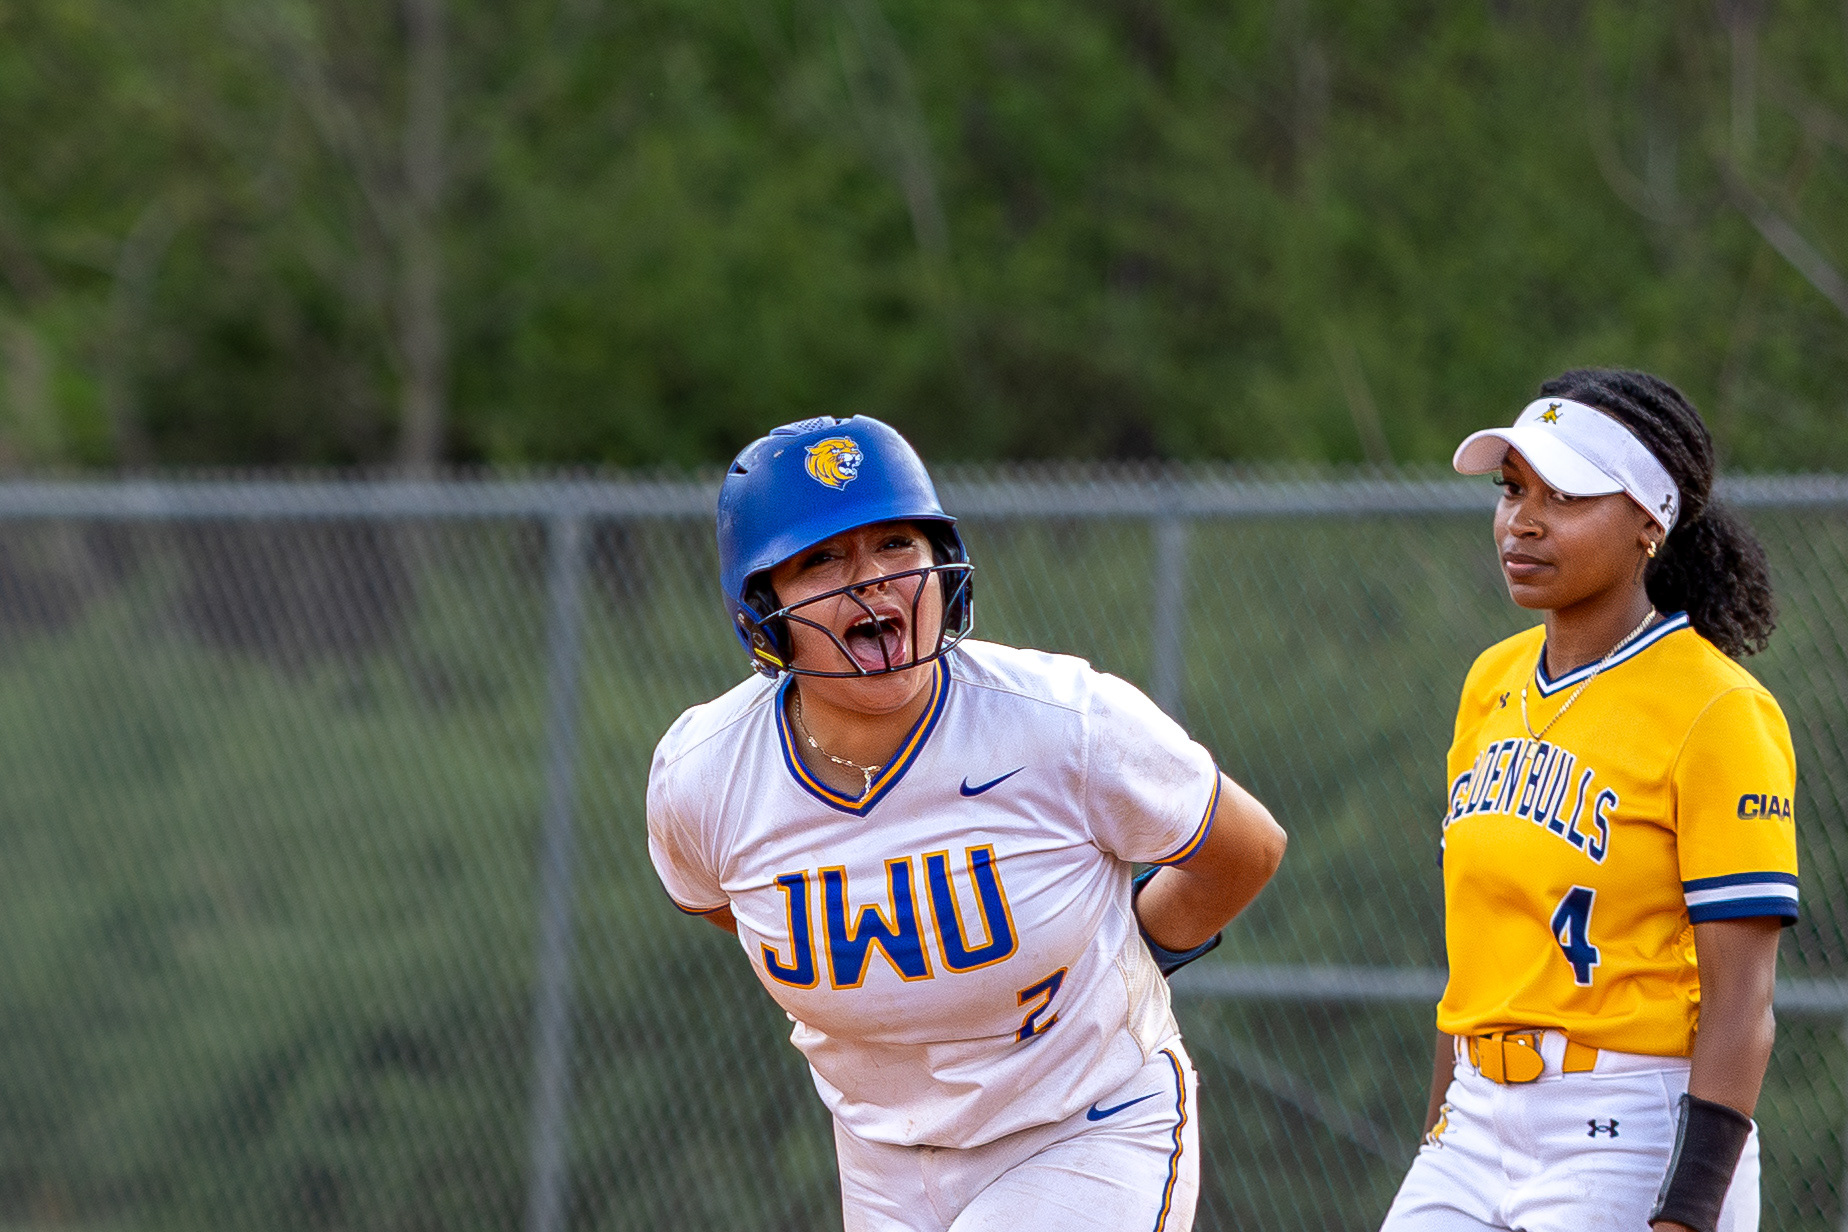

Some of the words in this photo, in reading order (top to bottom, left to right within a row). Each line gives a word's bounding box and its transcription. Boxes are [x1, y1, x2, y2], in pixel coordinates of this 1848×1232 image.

[1515, 739, 1619, 865] BULLS
[1737, 794, 1792, 823] CIAA
[760, 843, 1019, 991] JWU
[1550, 885, 1601, 987] 4
[1015, 966, 1068, 1043] 2
